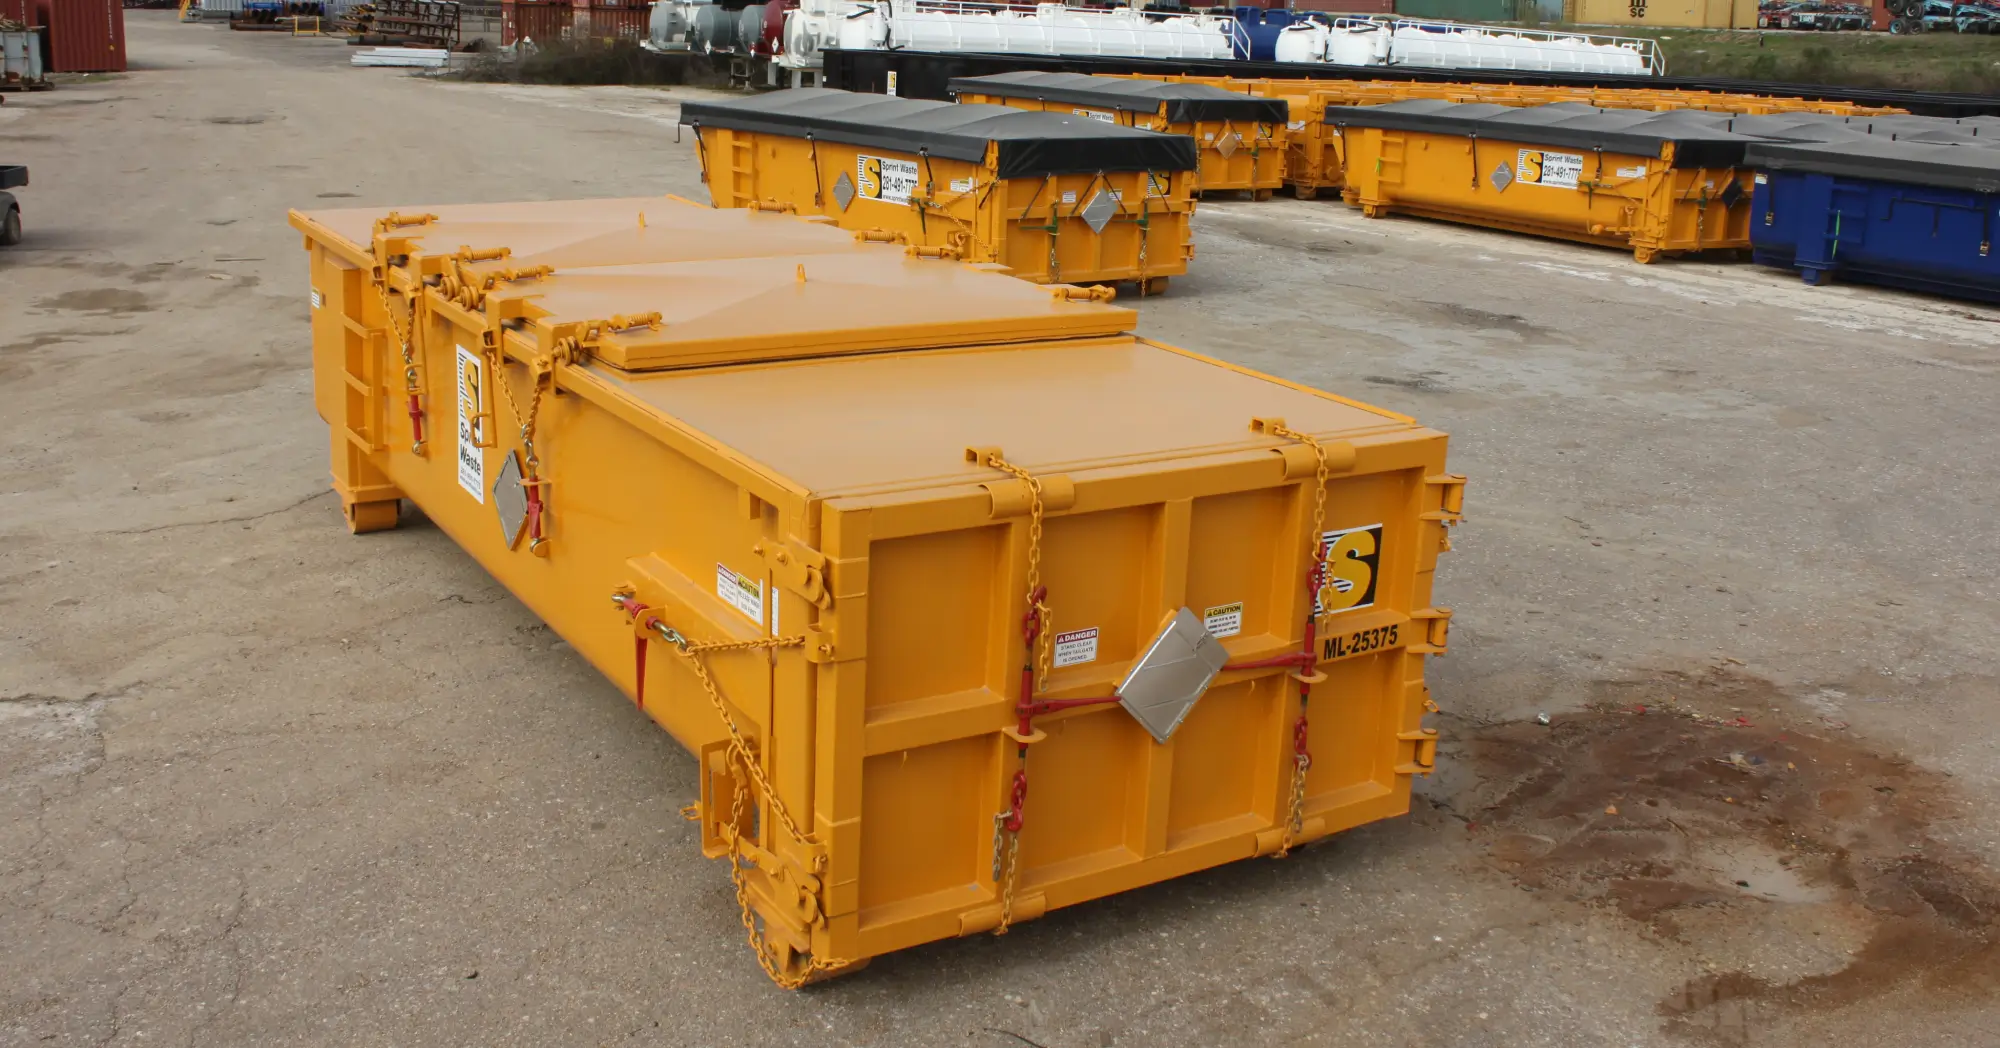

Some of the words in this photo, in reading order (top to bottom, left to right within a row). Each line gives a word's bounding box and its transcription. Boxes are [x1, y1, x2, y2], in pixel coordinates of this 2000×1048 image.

[882, 160, 899, 172] Sprint
[900, 163, 917, 175] Waste
[1521, 151, 1541, 183] S
[1544, 153, 1563, 162] Sprint
[1564, 155, 1582, 165] Waste
[863, 157, 881, 198] S
[459, 443, 481, 476] Waste
[1319, 530, 1376, 612] S
[1213, 605, 1240, 615] CAUTION
[1065, 630, 1096, 641] DANGER
[1323, 624, 1398, 660] ML-25375
